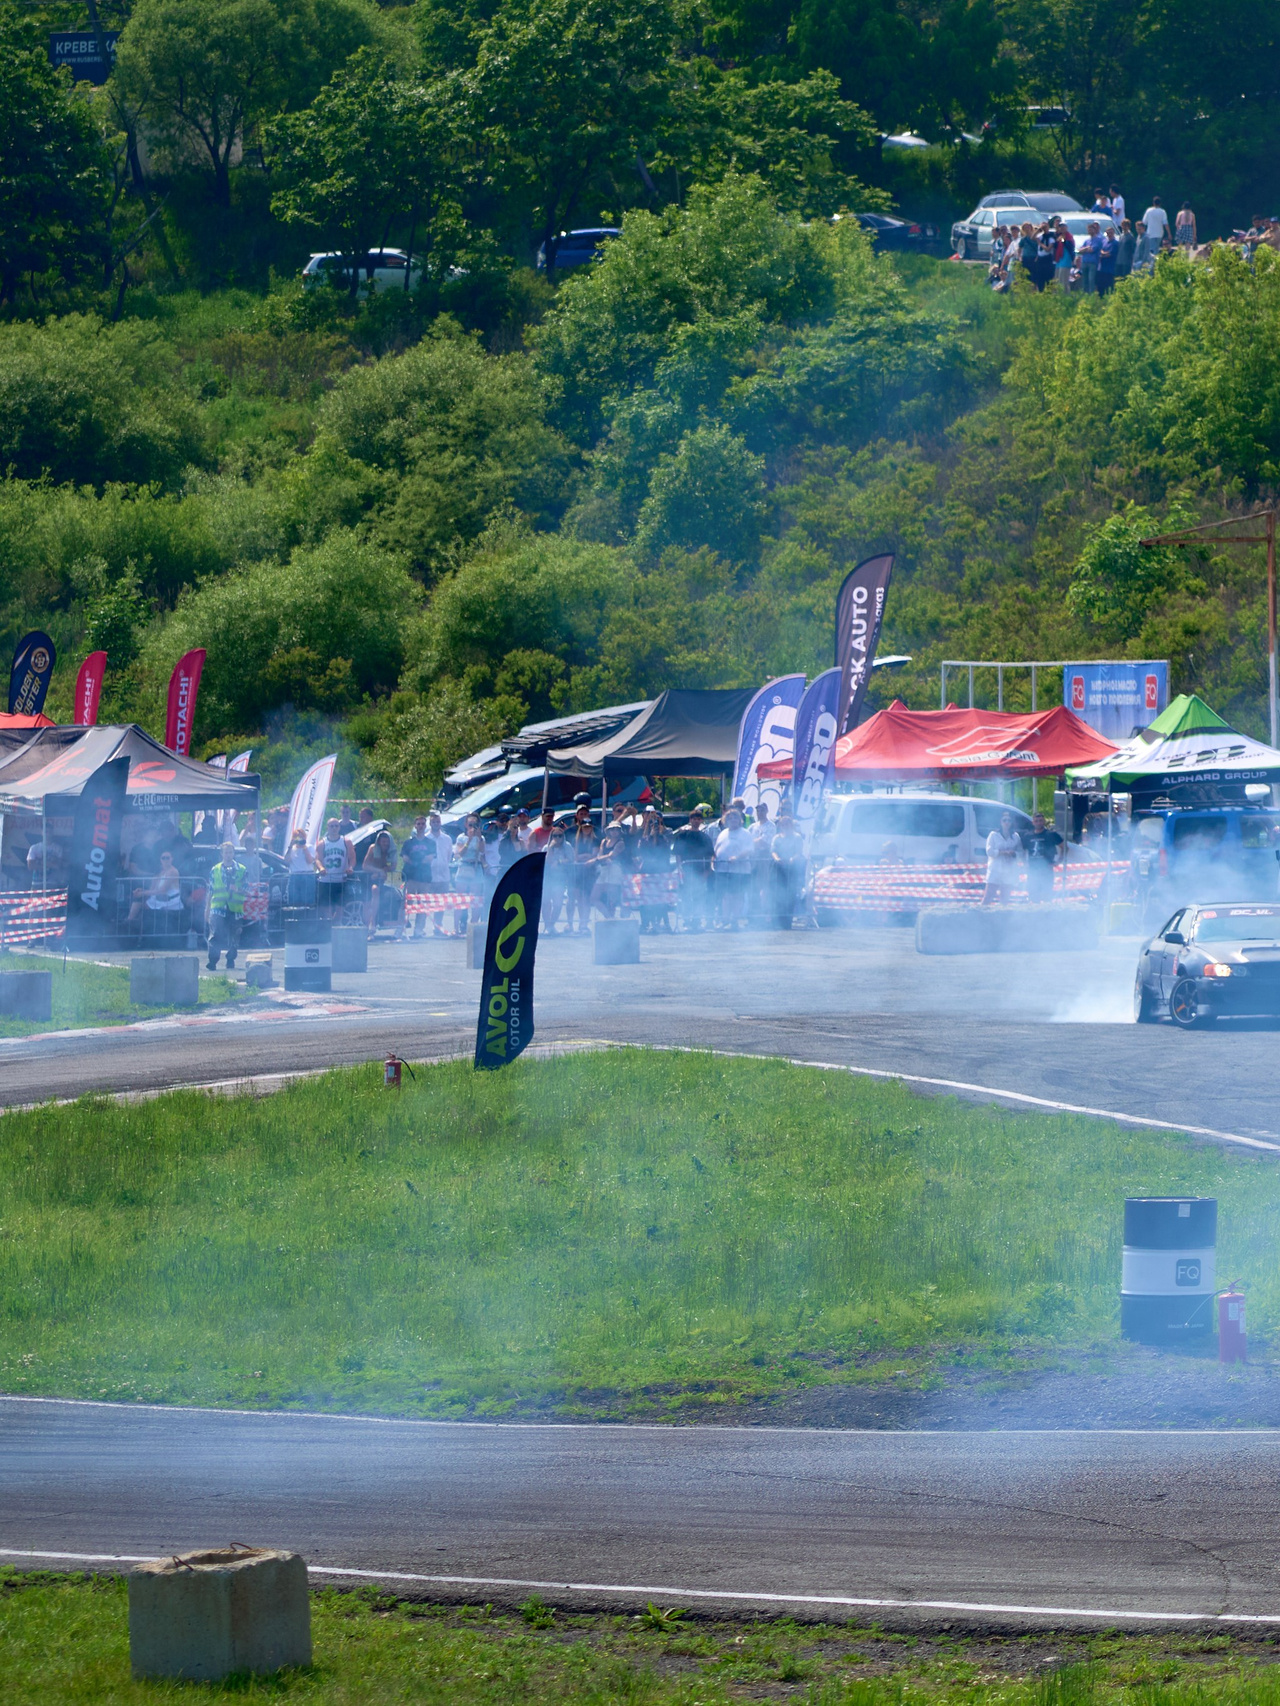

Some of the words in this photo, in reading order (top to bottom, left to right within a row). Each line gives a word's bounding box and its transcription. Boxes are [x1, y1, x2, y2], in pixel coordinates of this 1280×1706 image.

[852, 586, 868, 653] AUTO
[1145, 684, 1157, 700] FQ
[175, 677, 189, 755] TOTACHI
[1162, 772, 1221, 785] ALPHARD
[1224, 771, 1268, 781] GROUP
[80, 797, 112, 911] Automat
[325, 857, 342, 868] 33
[306, 952, 319, 960] FQ
[511, 977, 521, 1003] OIL
[485, 977, 509, 1058] AVOL
[510, 1006, 521, 1051] OTOR
[1177, 1265, 1200, 1280] FQ
